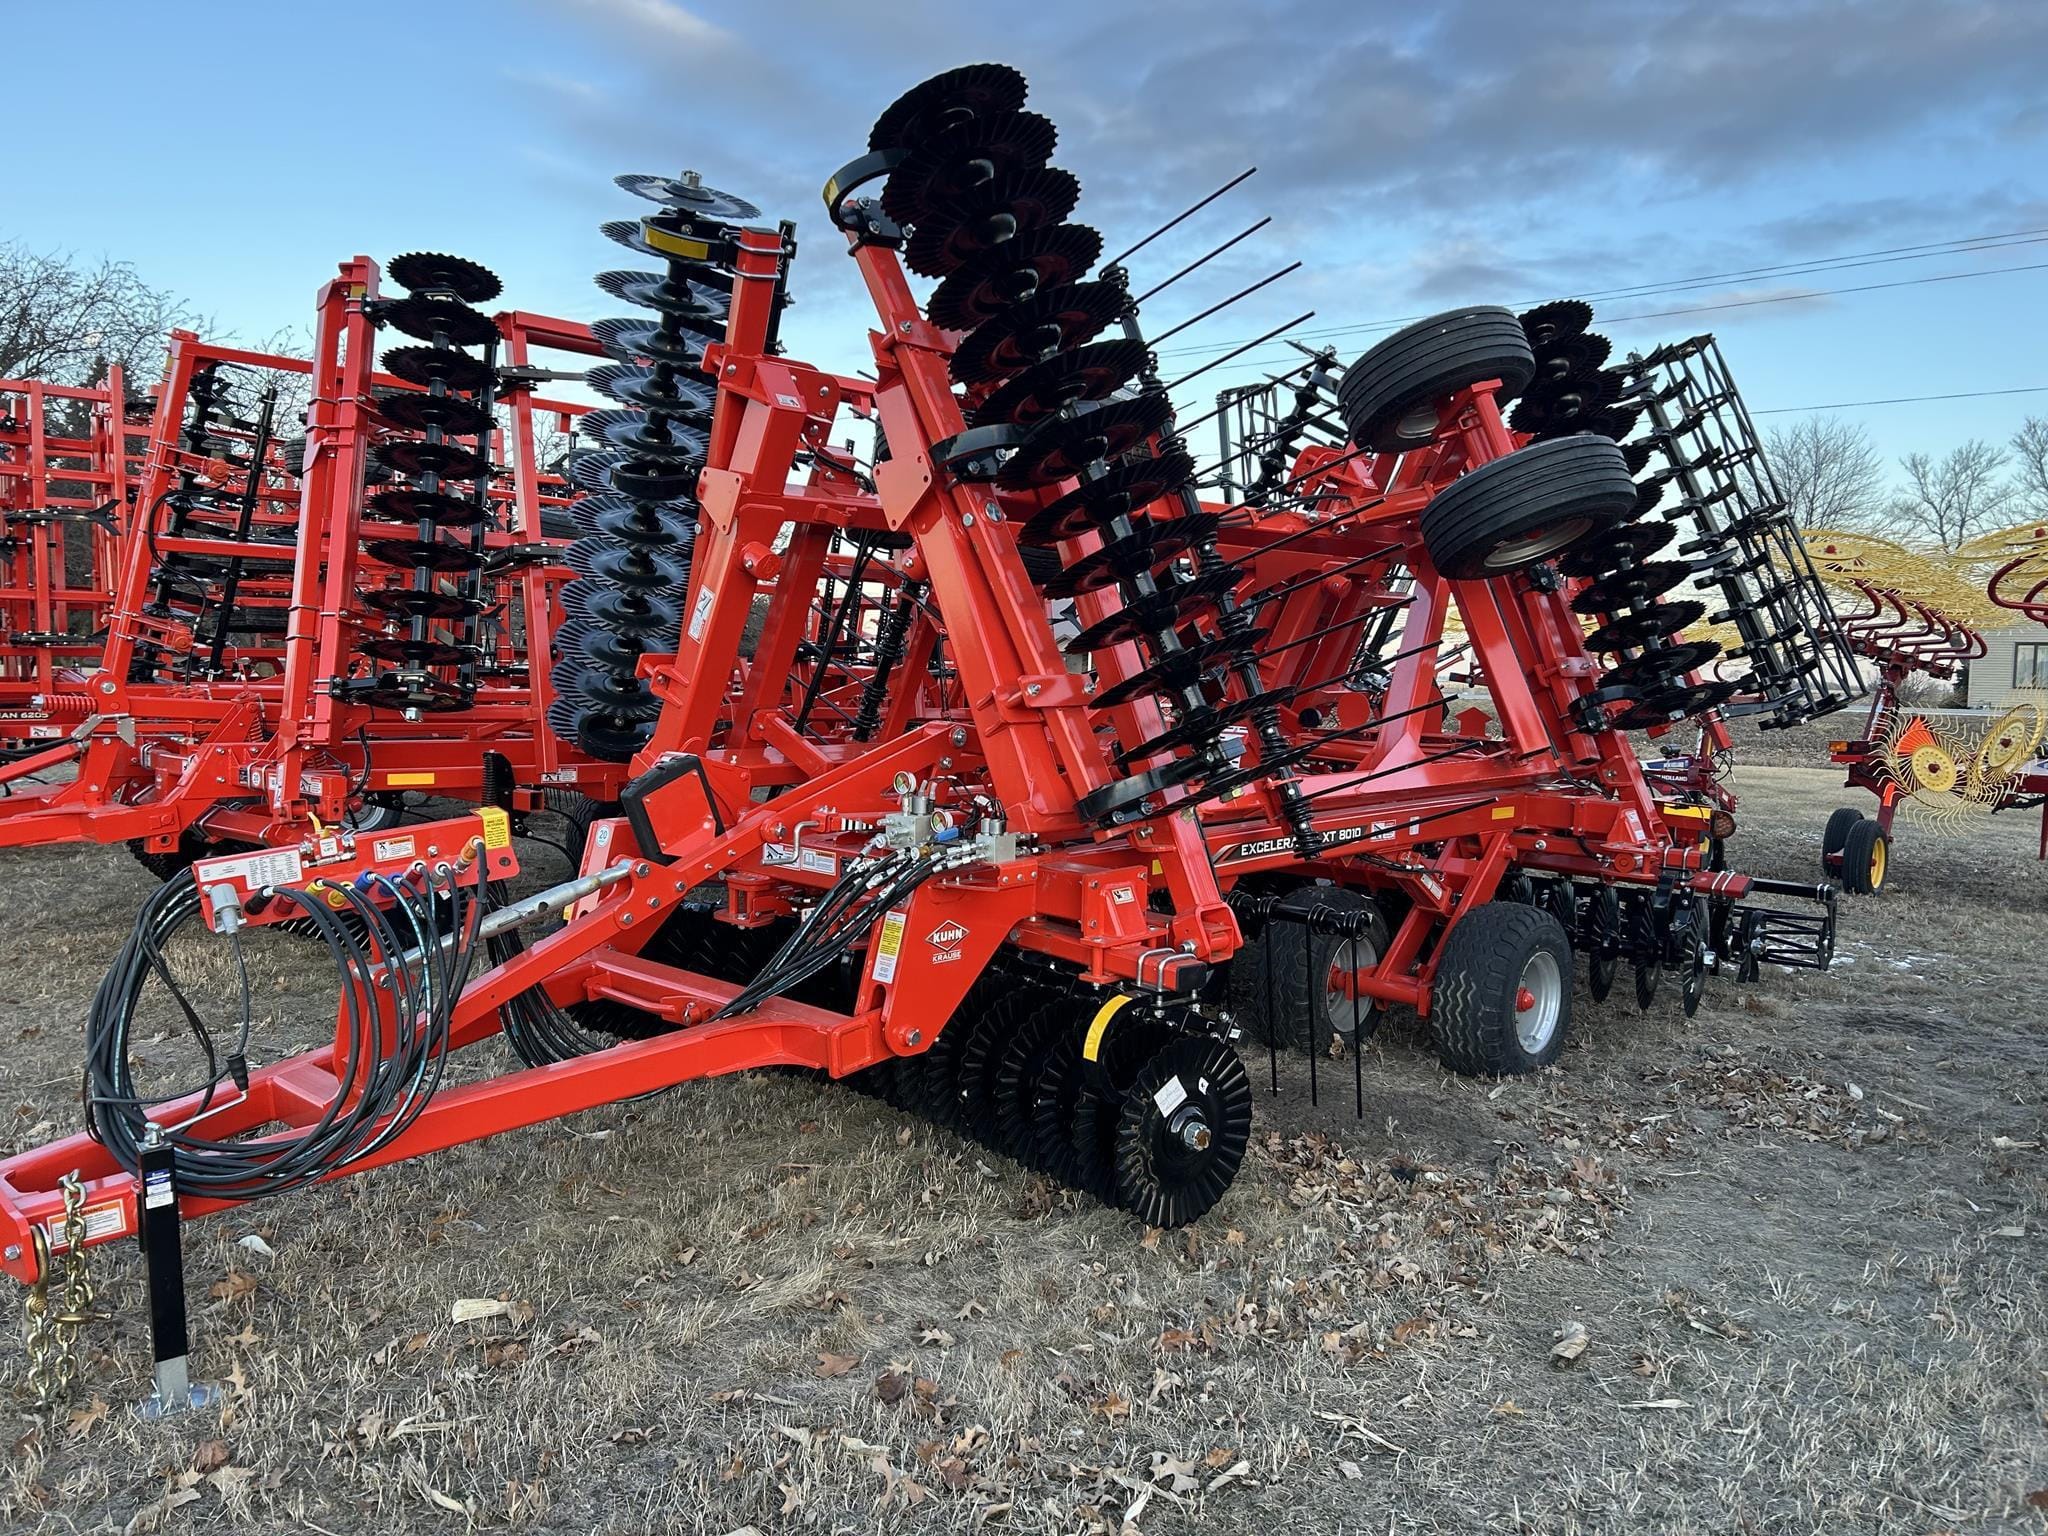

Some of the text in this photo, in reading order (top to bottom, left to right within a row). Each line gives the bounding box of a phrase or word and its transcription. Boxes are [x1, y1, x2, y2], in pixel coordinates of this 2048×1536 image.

[599, 829, 608, 840] 20
[1322, 830, 1337, 843] XT
[1339, 827, 1361, 841] 8010
[933, 928, 963, 944] KUHN
[932, 951, 962, 963] KRAUSE
